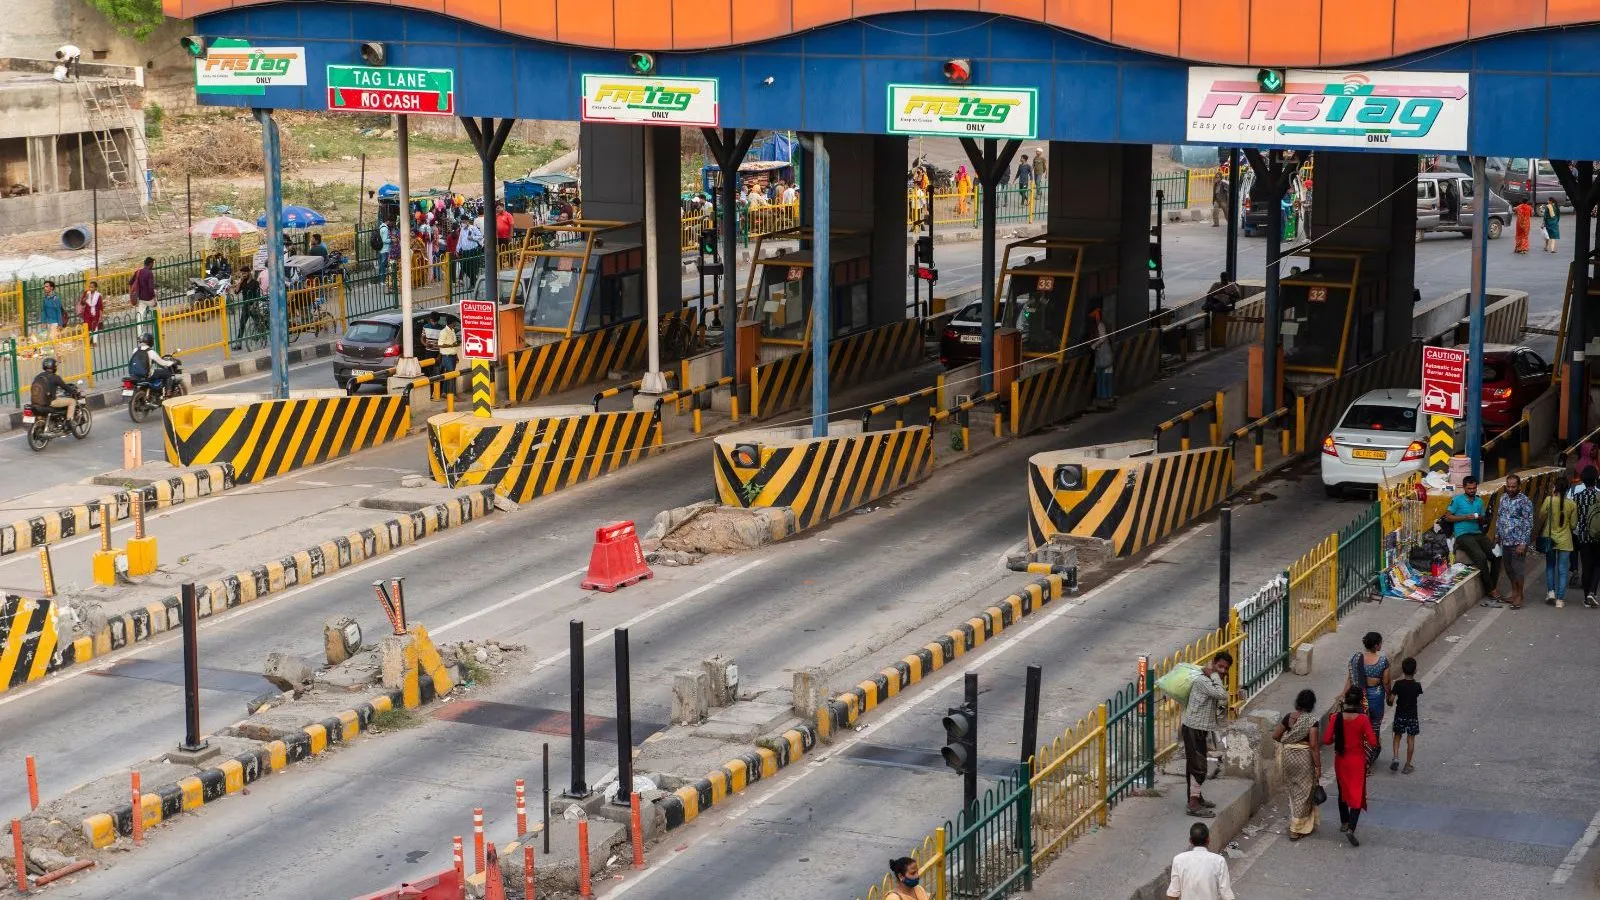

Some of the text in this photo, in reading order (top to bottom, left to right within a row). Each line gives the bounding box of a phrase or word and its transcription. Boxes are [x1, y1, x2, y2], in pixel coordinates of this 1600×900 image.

[205, 53, 297, 76] FASTag
[353, 71, 427, 88] TAG LANE
[361, 92, 420, 109] NO CASH
[594, 84, 700, 111] FASTag
[904, 95, 1020, 124] FASTag
[1197, 80, 1466, 138] FASTag
[652, 111, 669, 119] ONLY
[966, 123, 985, 132] ONLY
[1192, 121, 1272, 132] Easy to Cruise
[1367, 134, 1388, 144] ONLY
[1039, 280, 1052, 289] 33
[1310, 290, 1325, 300] 32
[1427, 350, 1462, 361] CAUTION
